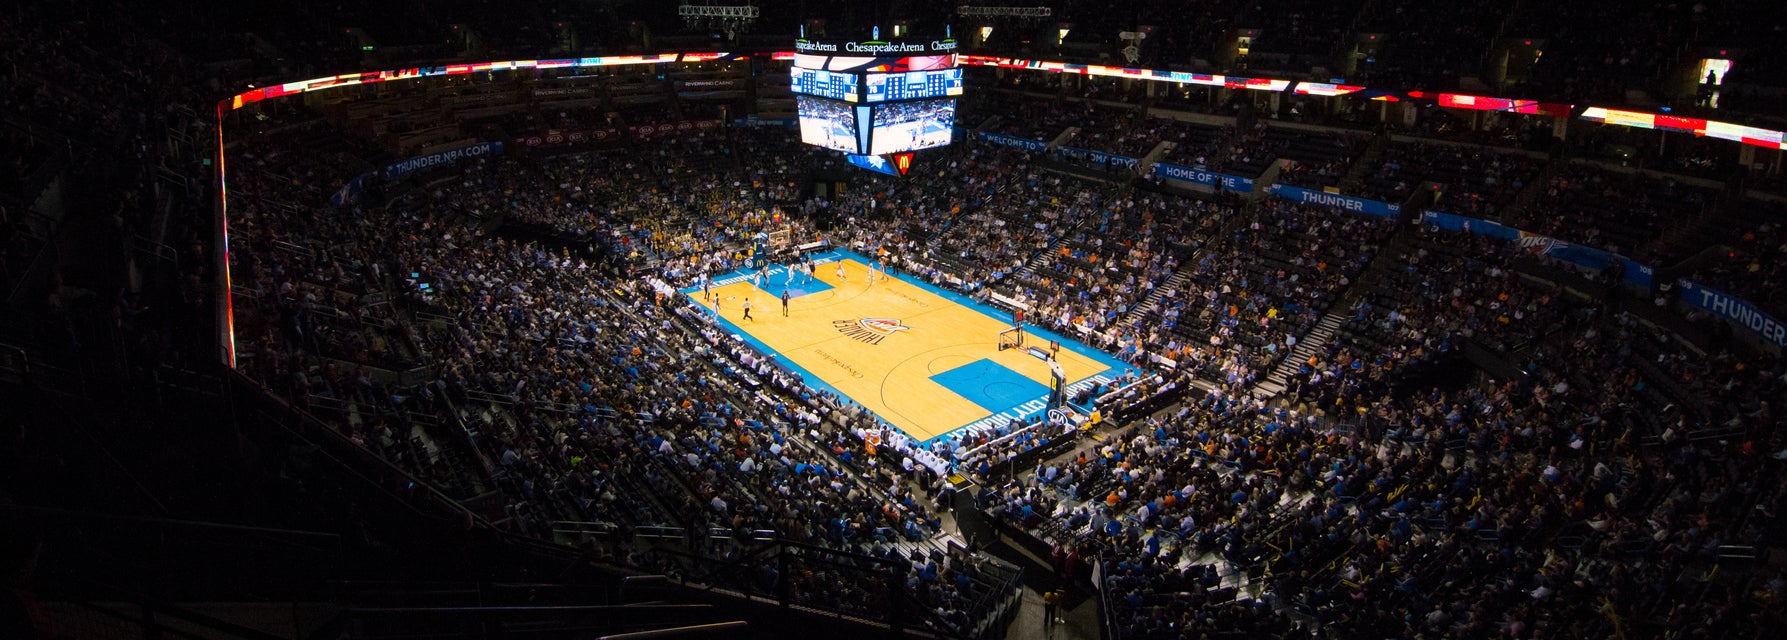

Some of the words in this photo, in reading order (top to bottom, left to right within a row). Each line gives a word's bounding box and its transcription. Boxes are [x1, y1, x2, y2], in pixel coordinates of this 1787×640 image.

[816, 41, 837, 51] Arena
[845, 42, 900, 55] Chesapeake
[900, 42, 924, 51] Arena
[987, 135, 1023, 147] WELCOME
[1025, 141, 1036, 149] TO
[396, 144, 490, 173] THUNDER.NBA.COM
[1166, 167, 1195, 180] HOME
[1197, 172, 1212, 182] OF
[1215, 175, 1235, 187] HE
[1302, 191, 1363, 211] THUNDER
[1387, 203, 1399, 211] 107
[1520, 236, 1546, 248] OKC
[1700, 289, 1785, 346] THUNDER
[832, 319, 885, 346] THUNDER
[1013, 398, 1047, 421] CITY
